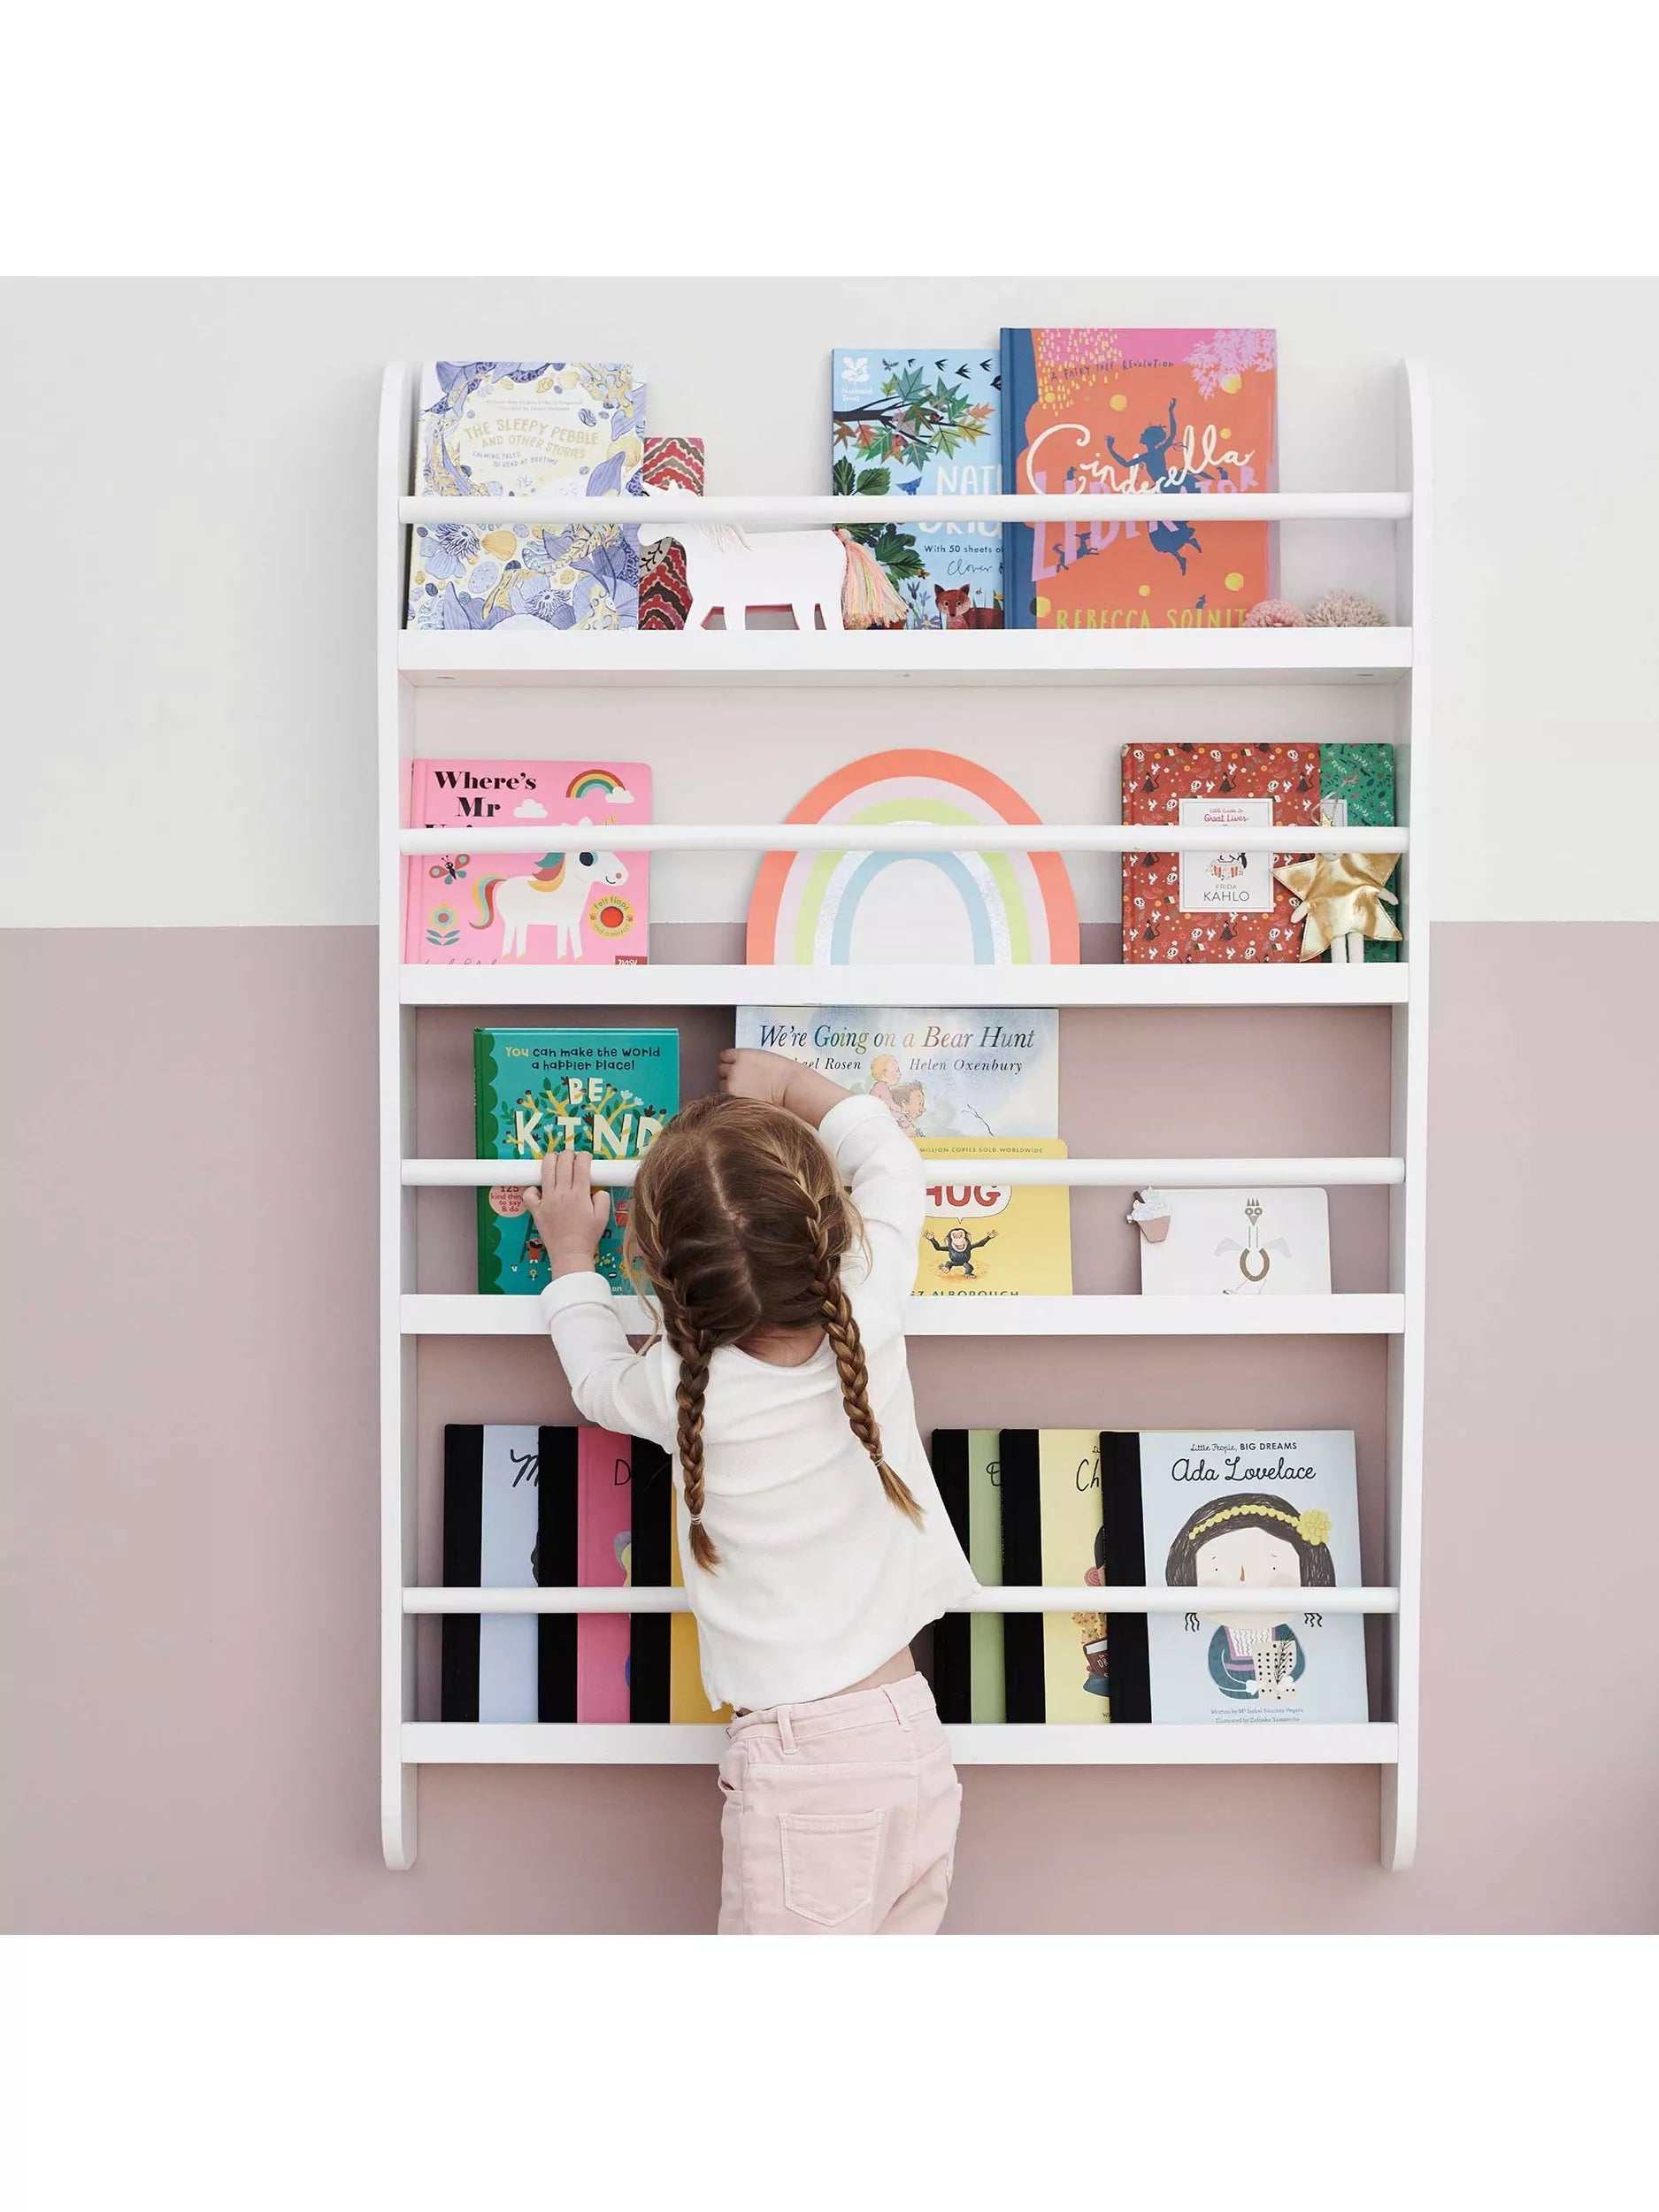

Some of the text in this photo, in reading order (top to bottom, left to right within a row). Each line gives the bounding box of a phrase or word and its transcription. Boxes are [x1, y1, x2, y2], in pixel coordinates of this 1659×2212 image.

[1064, 366, 1090, 380] FAIRY
[1096, 362, 1114, 373] TALE
[464, 419, 599, 444] THE SLEEPY PEBBLE
[482, 435, 587, 458] AND OTHER STORIES
[531, 456, 559, 465] BEDTIME
[1056, 610, 1151, 628] REBECCA
[434, 771, 536, 790] Where's
[455, 796, 501, 817] Mr
[594, 896, 629, 910] Felt flaps
[1203, 891, 1250, 902] KAHLO
[759, 1024, 1036, 1055] We're Going on a Bear Hunt
[533, 1048, 557, 1057] can
[561, 1047, 593, 1057] make
[597, 1048, 618, 1057] the
[622, 1047, 660, 1057] world
[532, 1060, 634, 1070] a happier place!
[826, 1058, 861, 1070] Rosen
[910, 1058, 947, 1071] Helen
[954, 1058, 1023, 1074] Oxenbury
[567, 1077, 603, 1104] BE
[514, 1110, 663, 1156] KIND
[508, 1193, 524, 1202] thin
[1190, 1441, 1297, 1454] Little People, BIG DREAMS
[1171, 1456, 1317, 1482] Ada Lovelace
